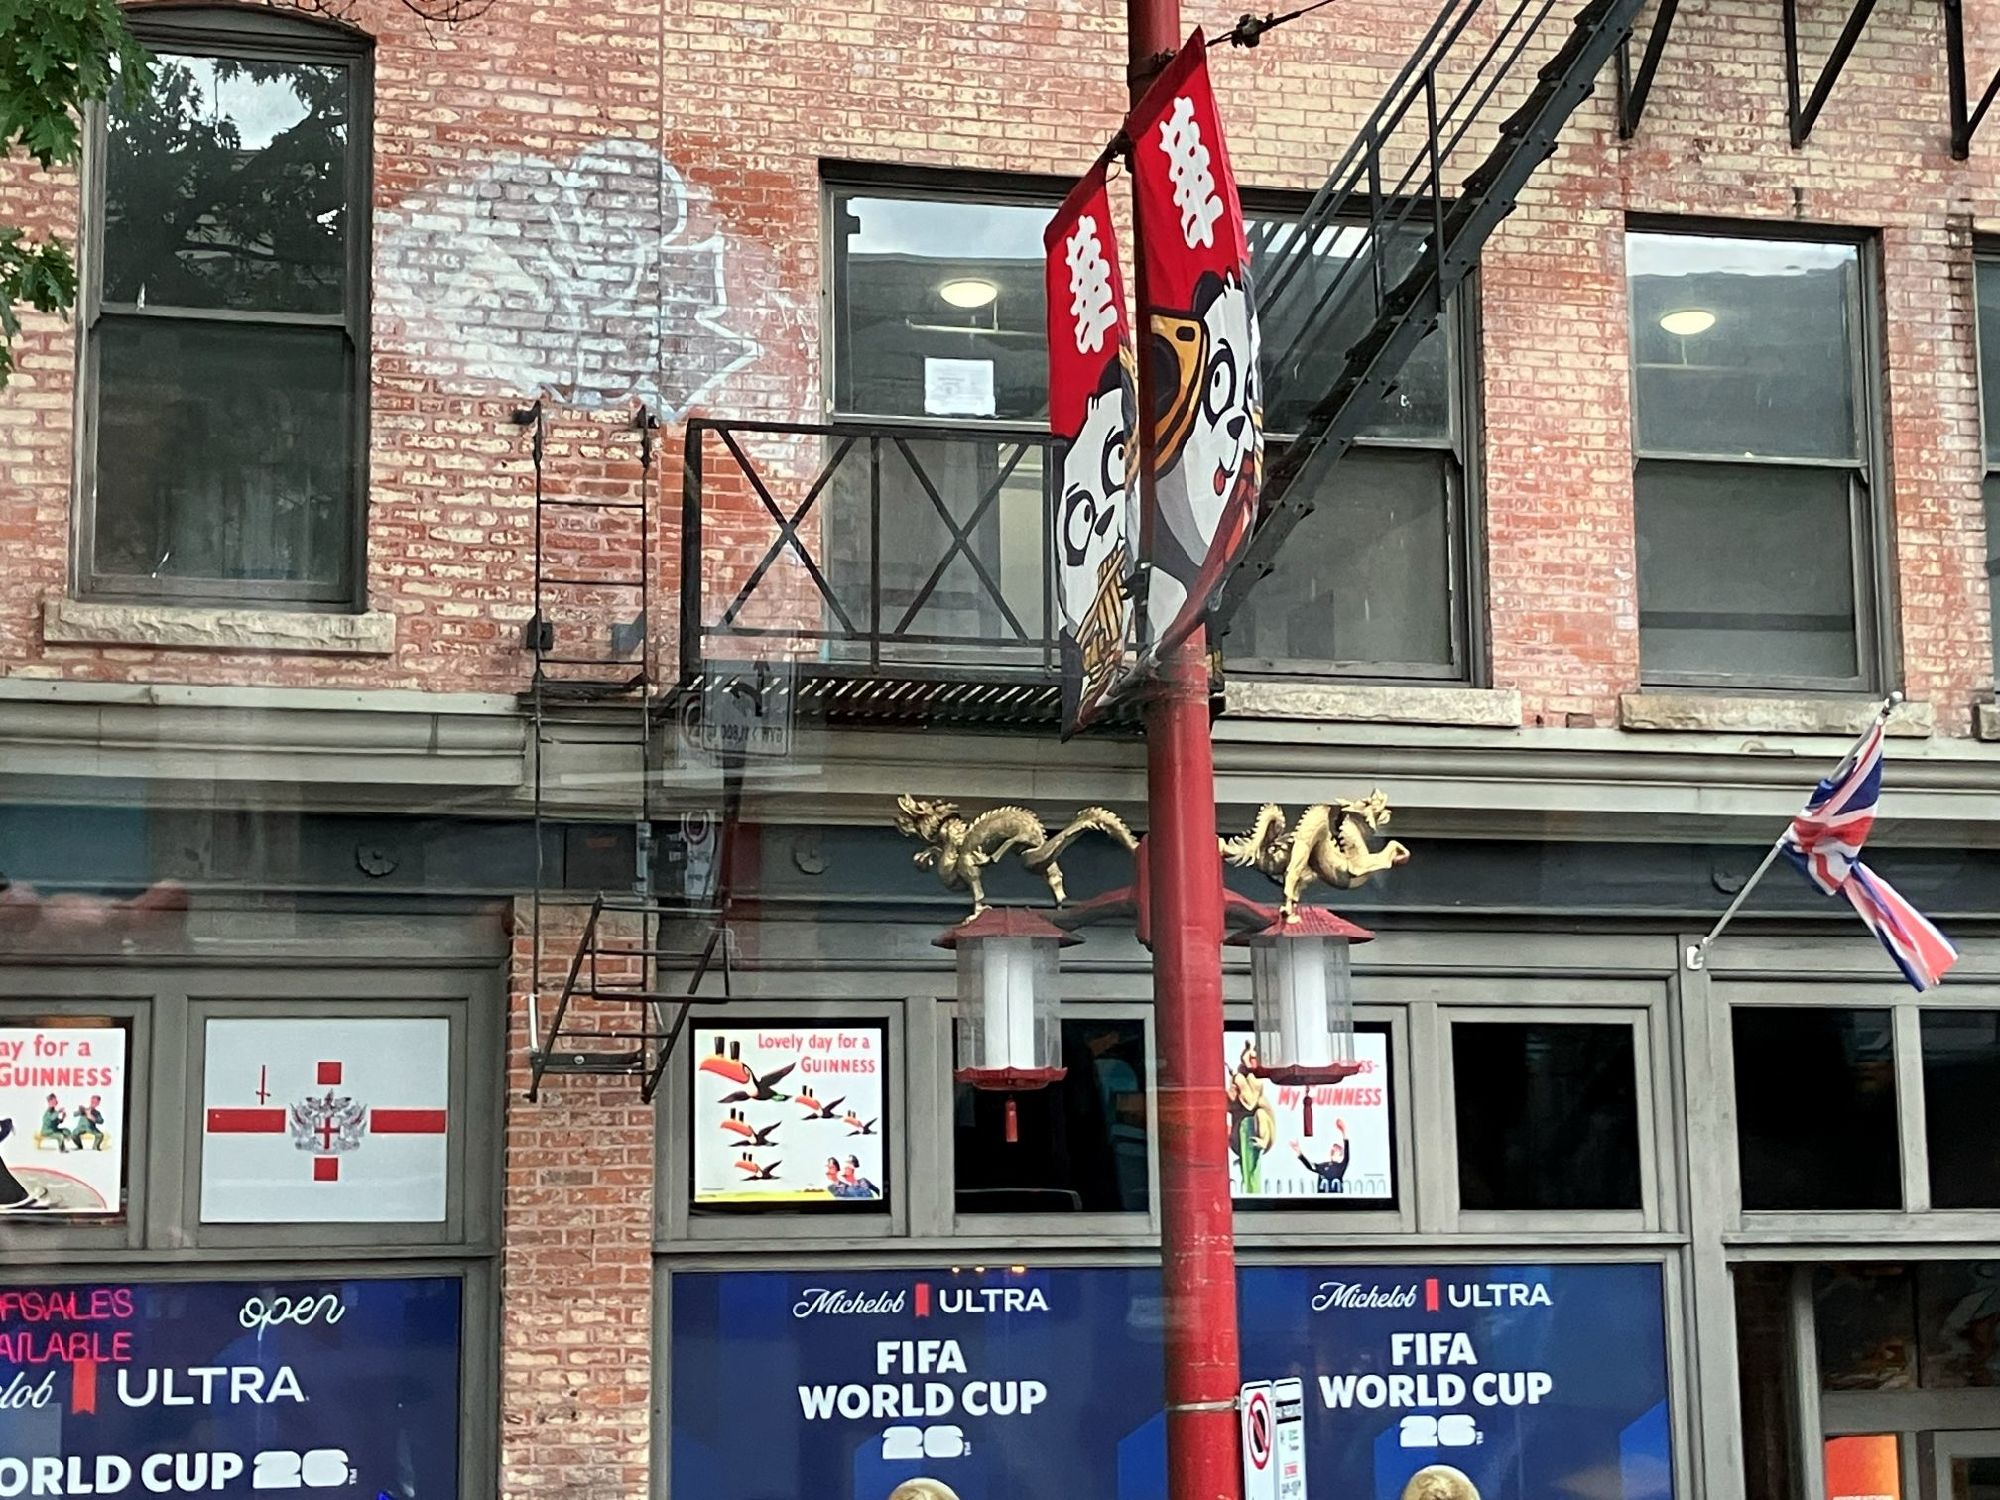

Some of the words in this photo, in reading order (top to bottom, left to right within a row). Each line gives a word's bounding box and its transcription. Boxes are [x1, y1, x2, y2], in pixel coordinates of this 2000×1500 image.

[33, 1034, 69, 1056] for
[78, 1041, 91, 1056] a
[758, 1033, 803, 1052] Lovely
[808, 1033, 833, 1052] day
[838, 1033, 858, 1049] for
[862, 1036, 870, 1049] a
[0, 1062, 112, 1087] GUINNESS
[801, 1056, 875, 1073] GUINNESS
[1278, 1086, 1300, 1110] My
[1309, 1086, 1382, 1106] UINNESS
[792, 1288, 906, 1317] Michelob
[939, 1288, 1048, 1313] ULTRA
[1312, 1281, 1417, 1311] Michelob
[1448, 1283, 1552, 1307] ULTRA
[239, 1294, 345, 1341] open
[877, 1340, 967, 1375] FIFA
[1391, 1332, 1478, 1366] FIFA
[0, 1370, 56, 1408] lob
[117, 1366, 306, 1407] ULTRA
[798, 1382, 954, 1420] WORLD
[961, 1380, 1047, 1416] CUP
[1319, 1373, 1466, 1408] WORLD
[1472, 1371, 1552, 1406] CUP
[882, 1425, 964, 1459] 26
[1400, 1414, 1477, 1448] 26
[141, 1451, 244, 1493] CUP
[252, 1449, 349, 1489] 26
